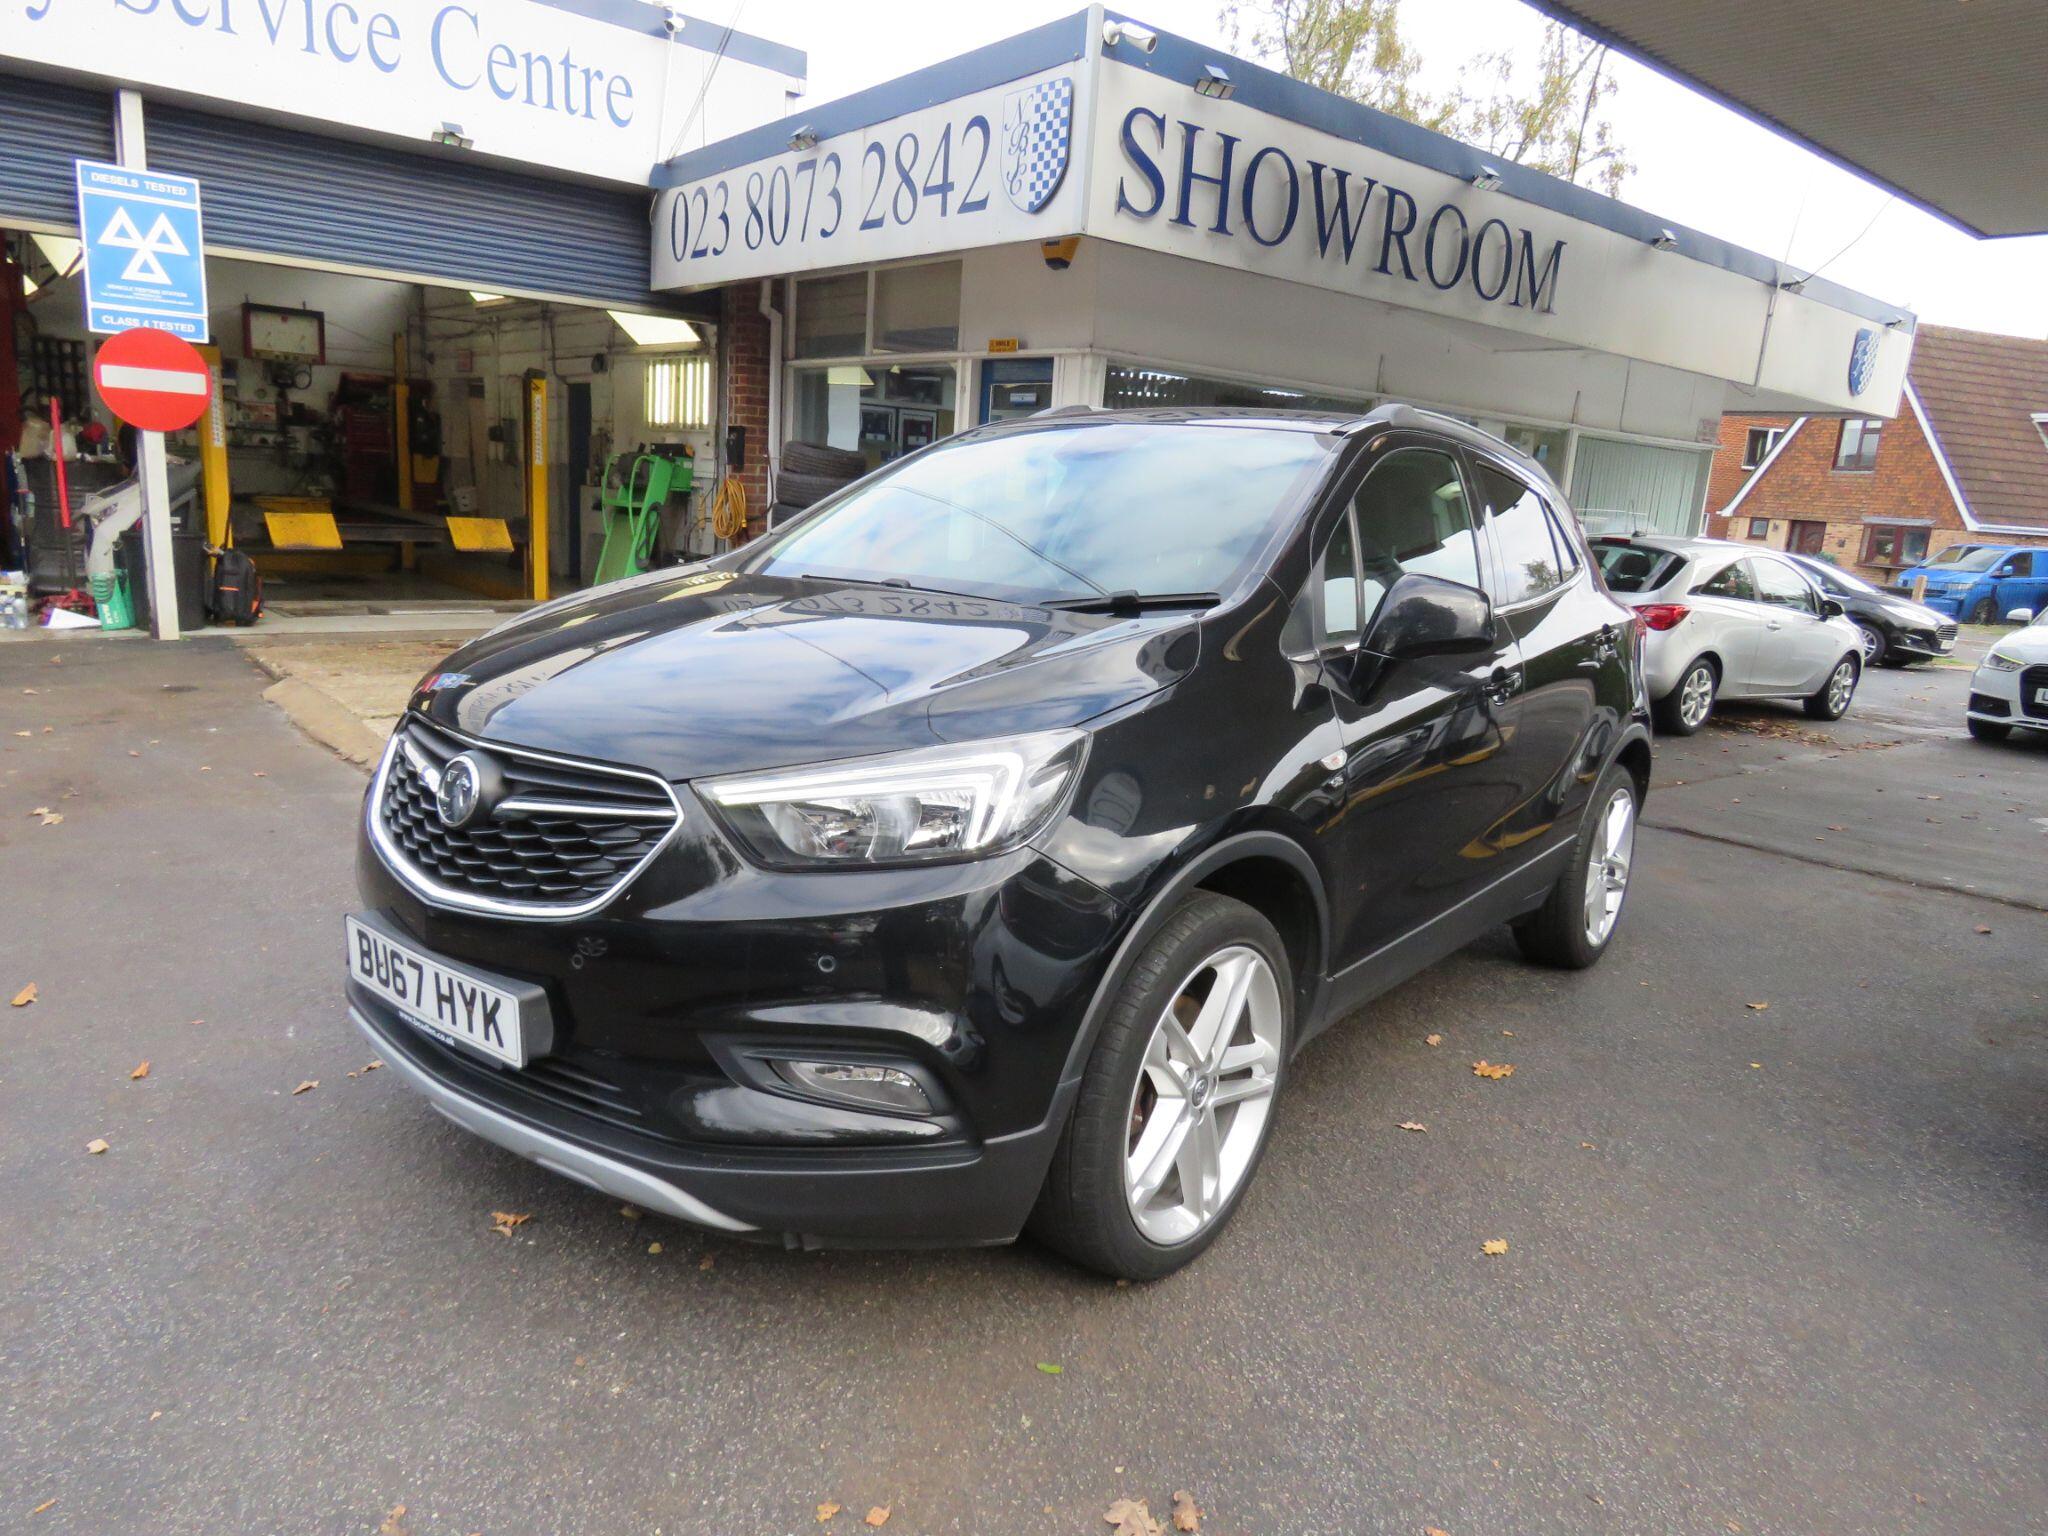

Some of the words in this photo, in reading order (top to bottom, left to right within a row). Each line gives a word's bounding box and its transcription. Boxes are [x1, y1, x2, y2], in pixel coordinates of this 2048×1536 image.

[115, 0, 402, 73] vice
[431, 5, 634, 128] Centre
[91, 172, 138, 188] DIESELS
[144, 181, 187, 196] TESTED
[671, 180, 730, 262] 023
[744, 153, 842, 250] 8073
[859, 115, 991, 232] 2842
[1116, 106, 1568, 315] SHOWROOM
[102, 315, 140, 328] CLASS
[152, 320, 195, 332] TESTED
[356, 928, 423, 1008] BU67
[434, 970, 504, 1048] HYK
